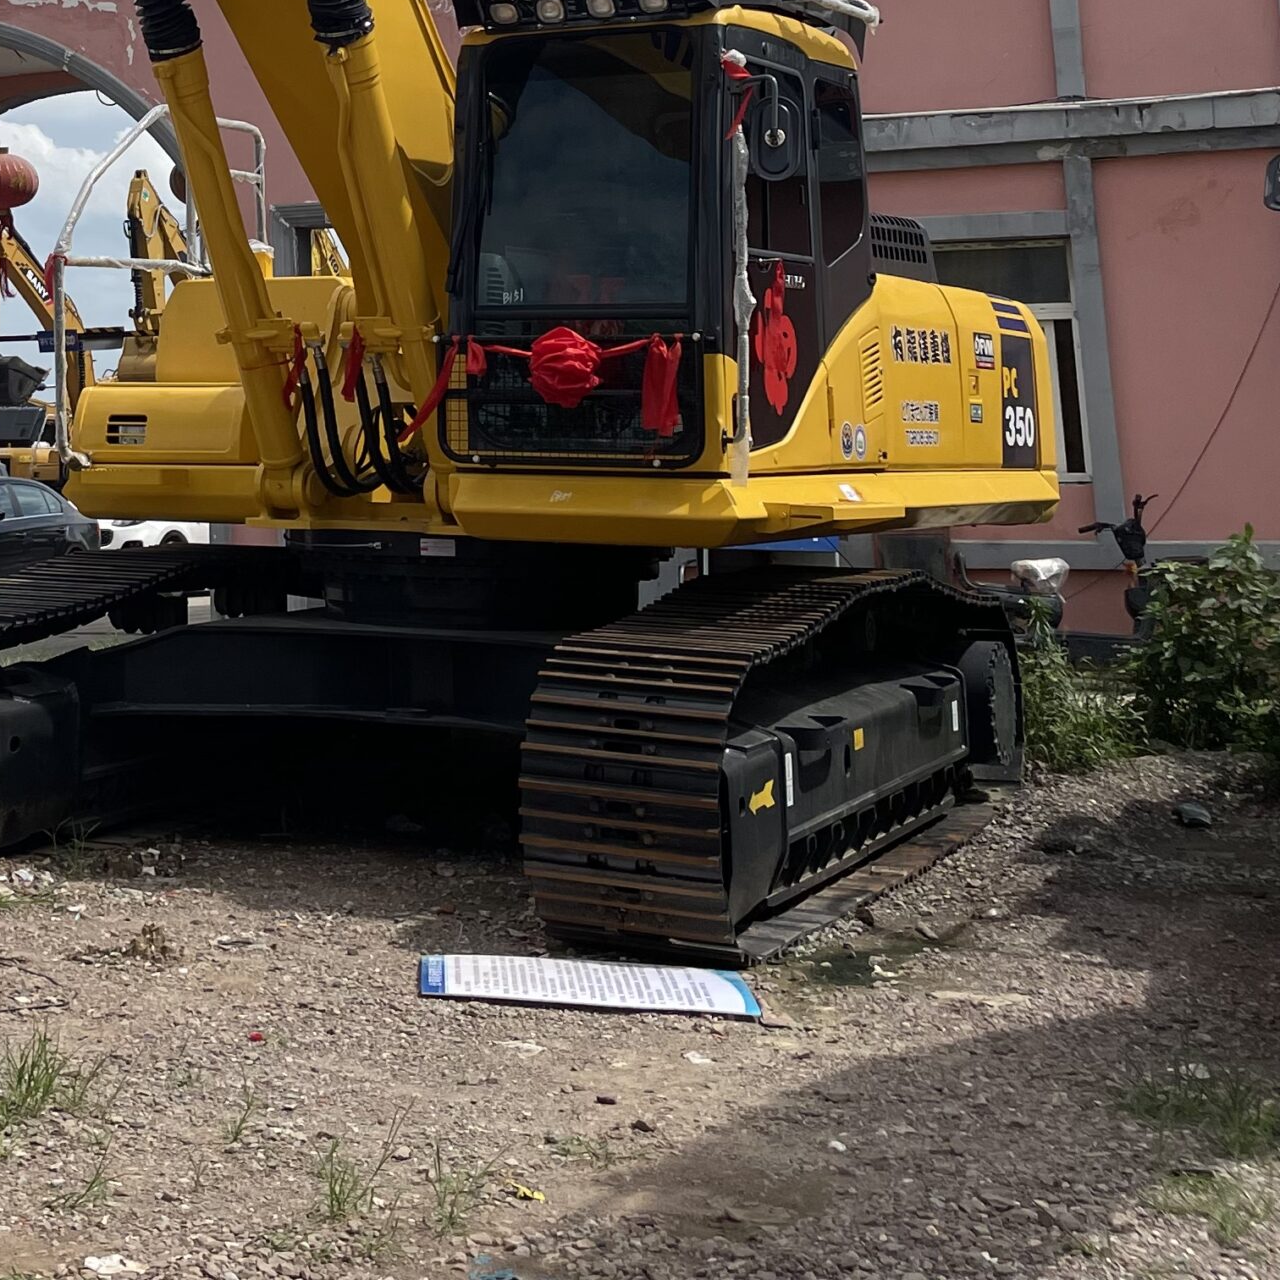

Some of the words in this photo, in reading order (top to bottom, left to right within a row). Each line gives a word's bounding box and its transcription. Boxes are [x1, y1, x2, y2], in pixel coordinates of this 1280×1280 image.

[26, 269, 49, 299] SANY
[1002, 366, 1019, 398] PC
[1005, 405, 1035, 447] 350
